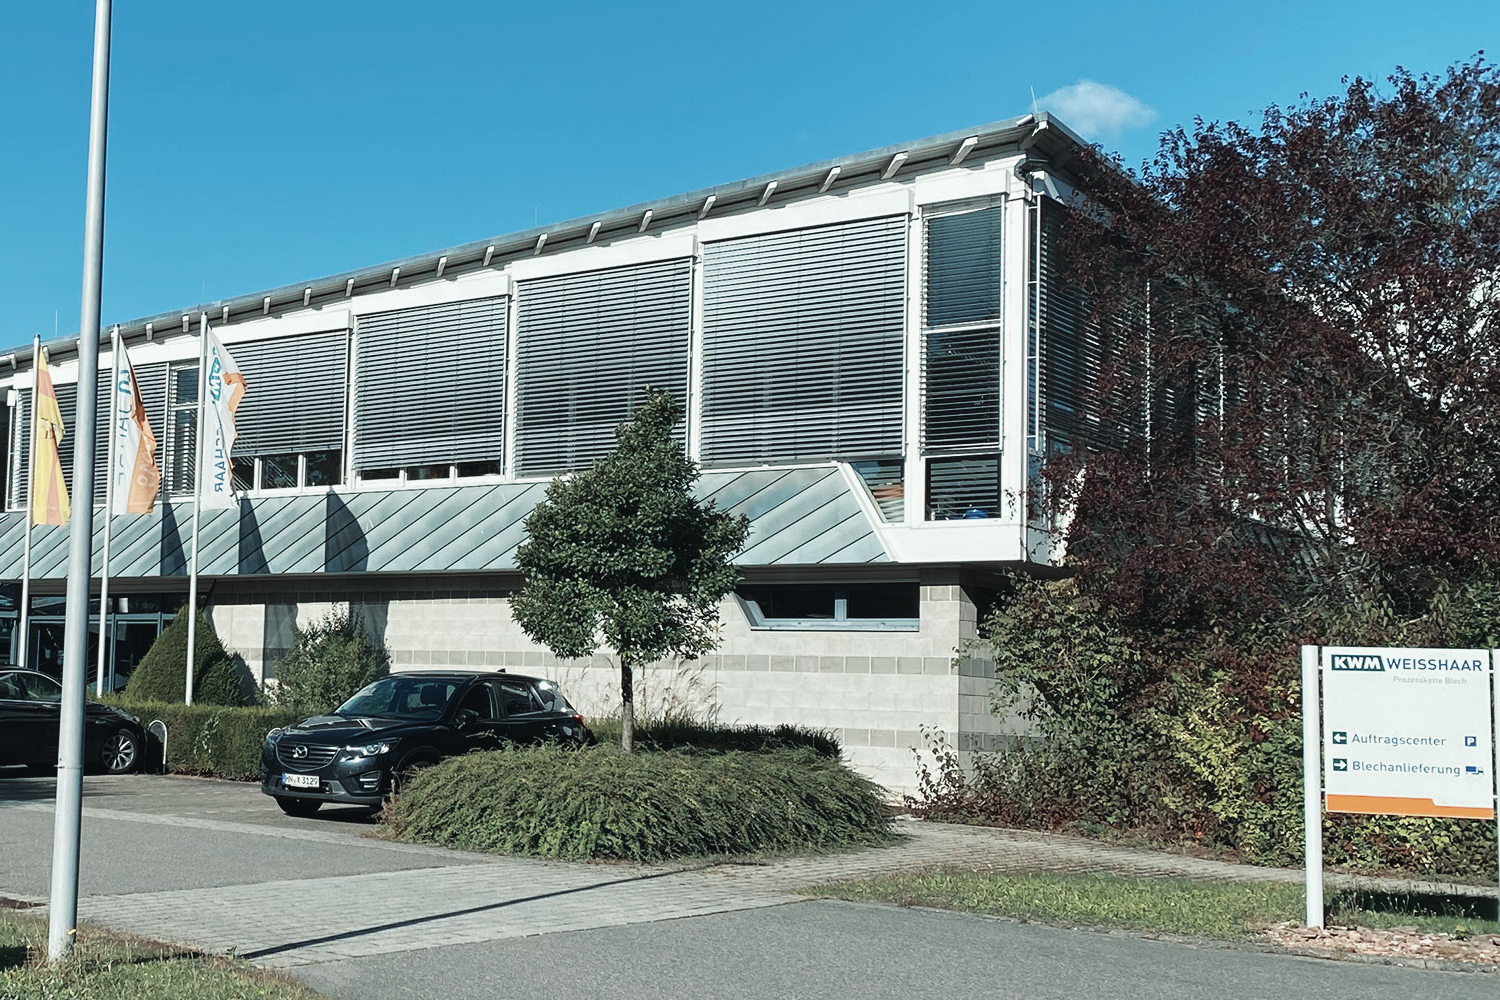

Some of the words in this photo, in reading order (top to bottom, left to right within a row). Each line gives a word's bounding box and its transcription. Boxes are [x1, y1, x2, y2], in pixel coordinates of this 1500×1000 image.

[1334, 656, 1381, 670] KWM
[1386, 658, 1483, 671] WEISSHAAR
[1445, 677, 1468, 685] Blech
[1352, 733, 1447, 747] Auftragscenter
[1352, 760, 1461, 777] Blechanlieferung
